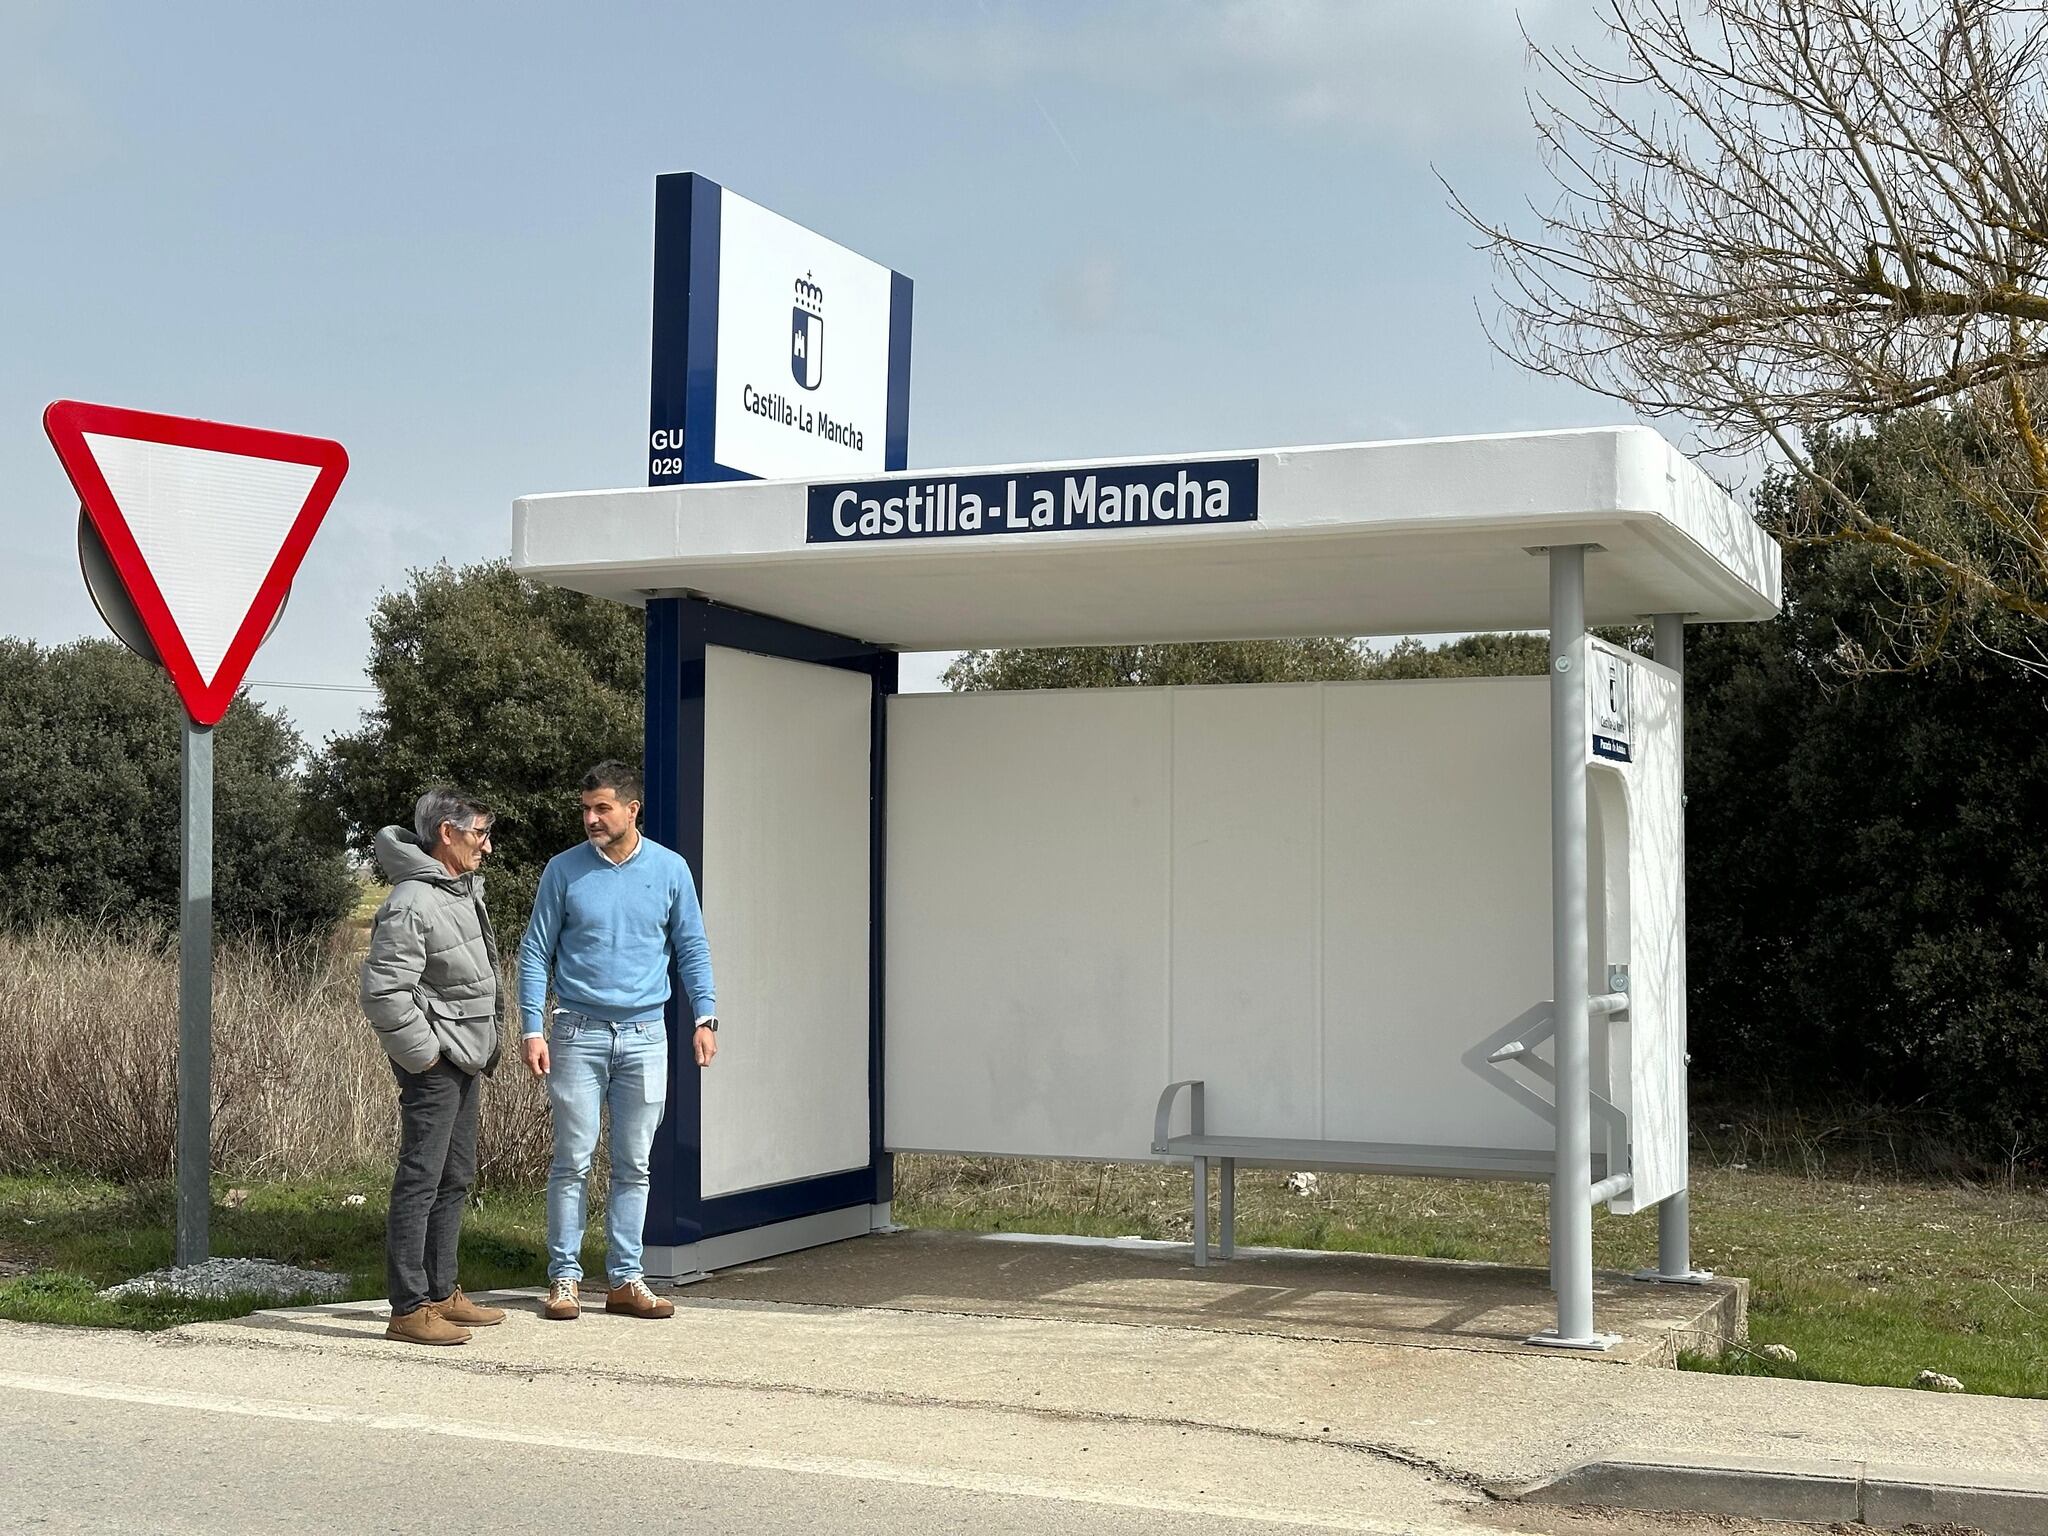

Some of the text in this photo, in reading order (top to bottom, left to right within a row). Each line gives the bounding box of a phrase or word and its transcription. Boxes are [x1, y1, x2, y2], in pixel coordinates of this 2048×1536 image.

[744, 383, 863, 451] Castilla-La Mancha
[651, 430, 683, 449] GU
[652, 458, 682, 475] 029
[1063, 471, 1230, 523] Mancha
